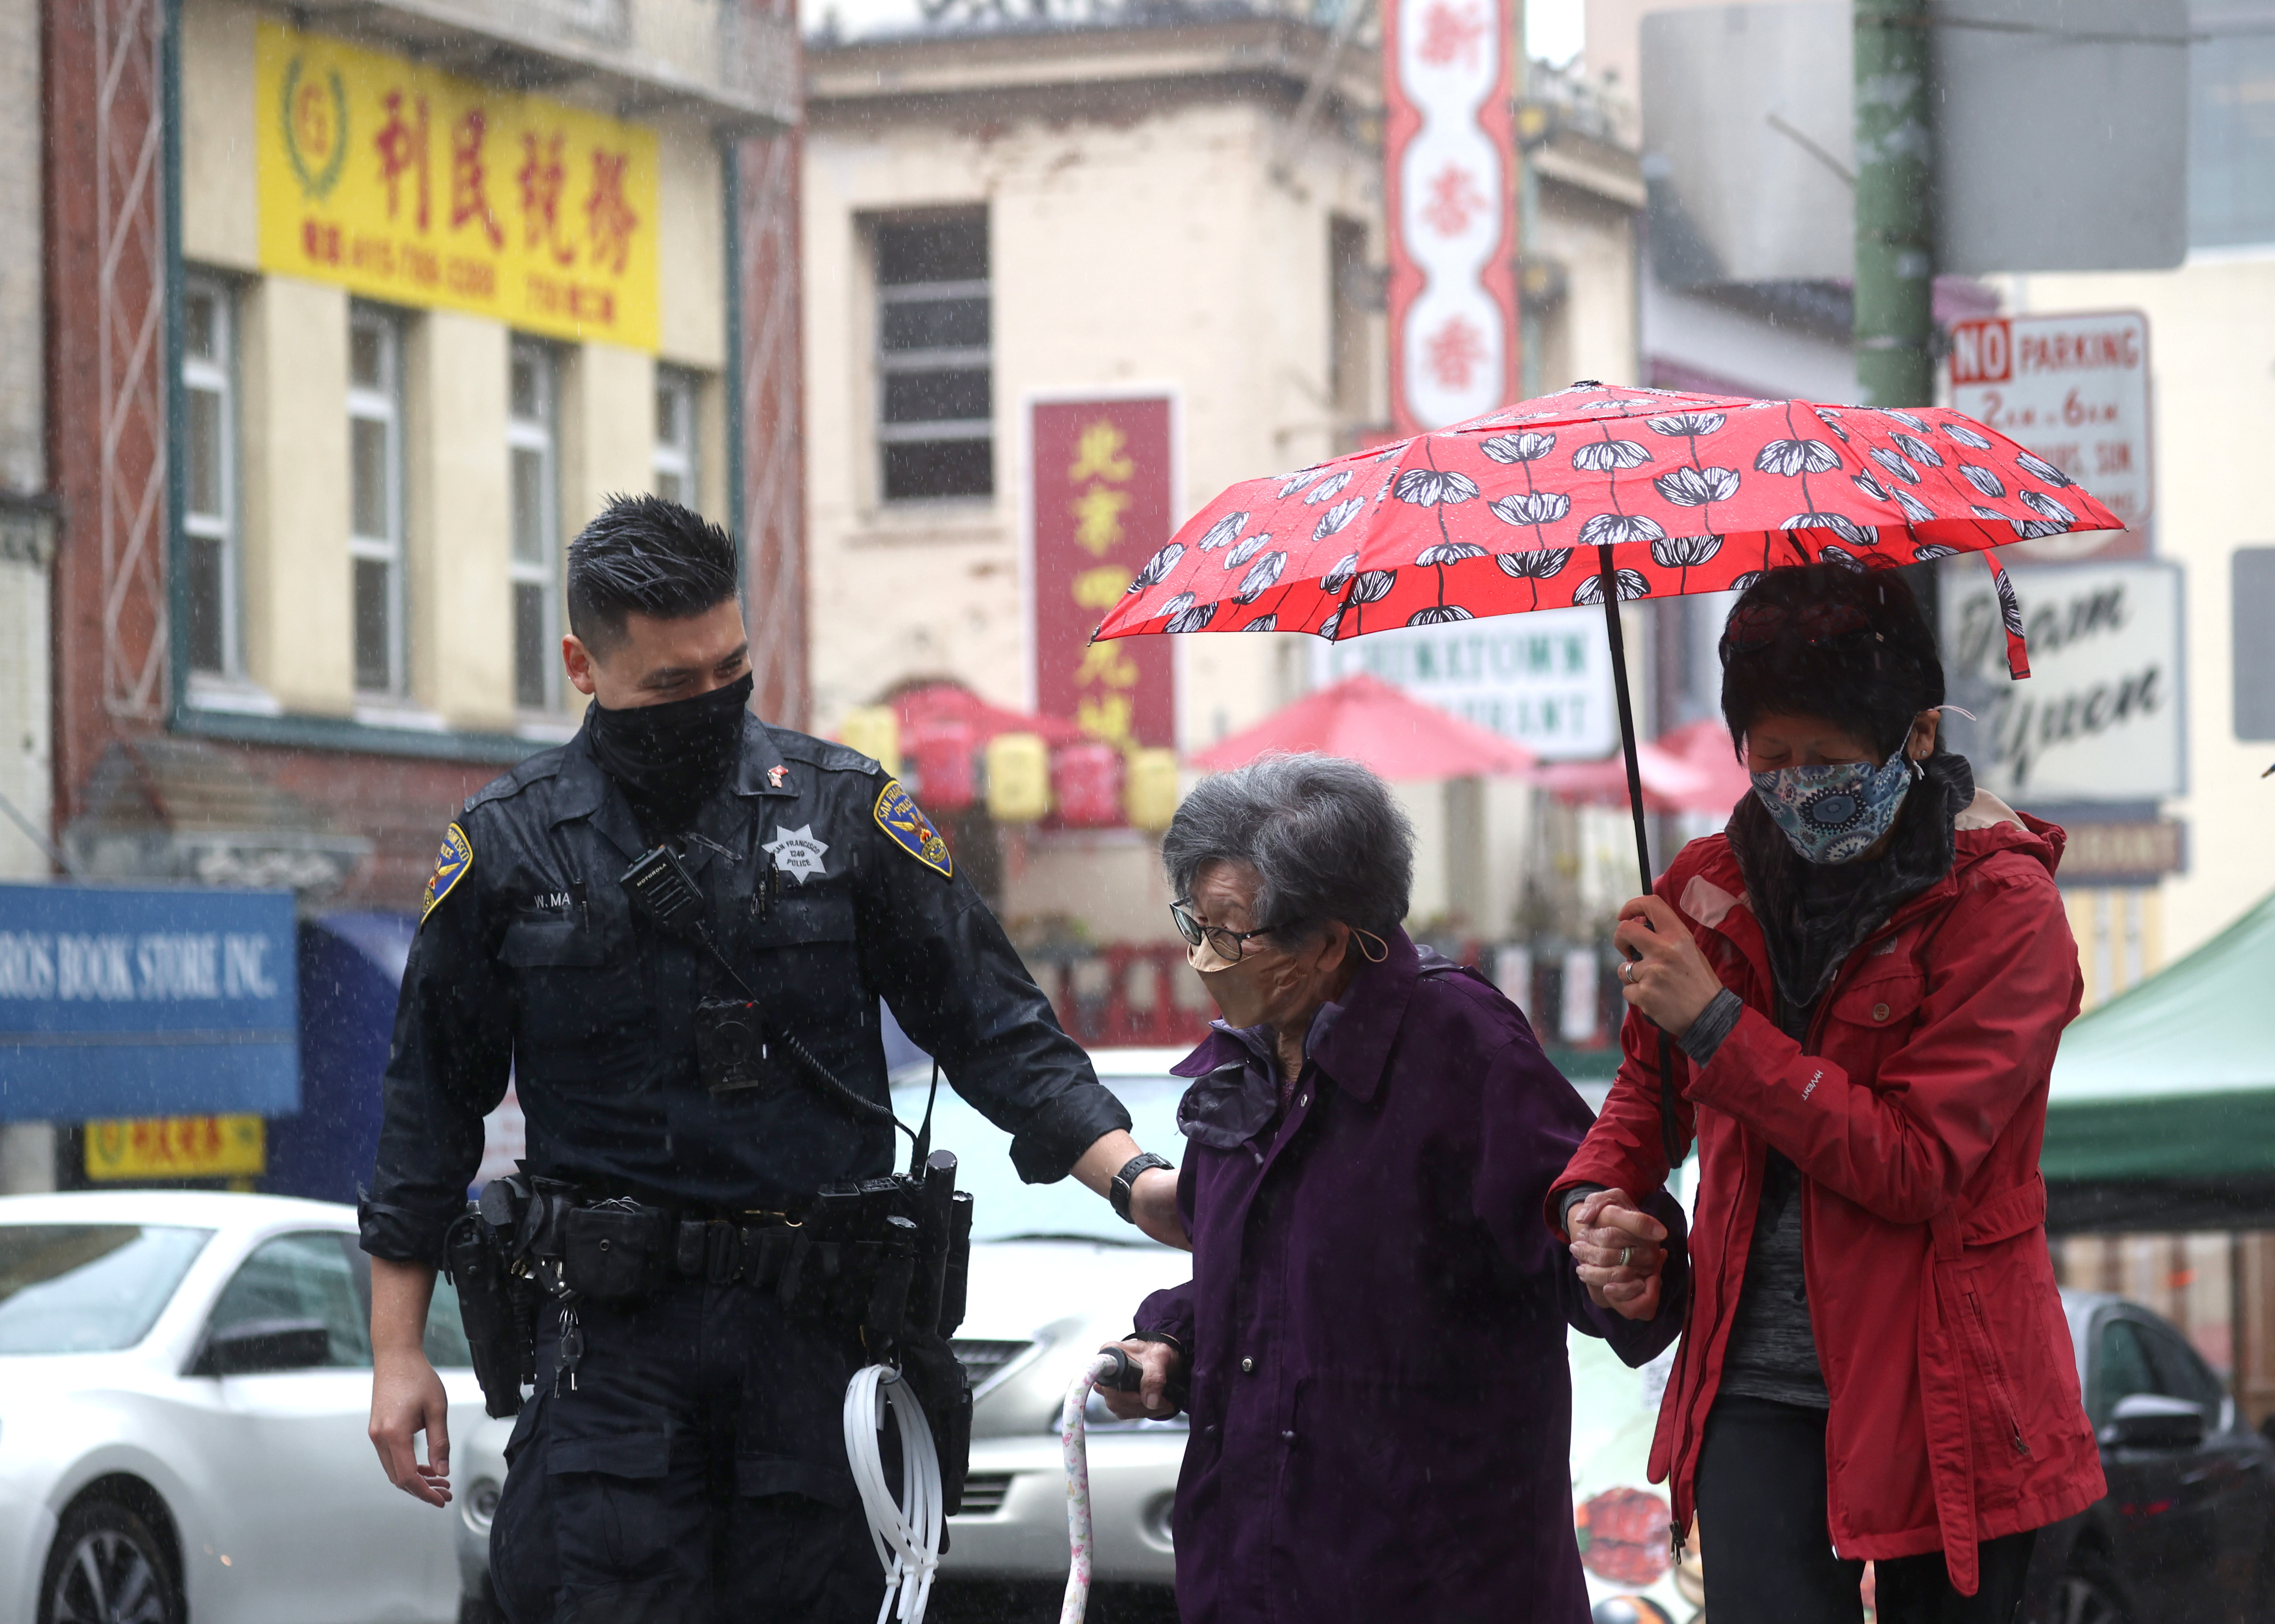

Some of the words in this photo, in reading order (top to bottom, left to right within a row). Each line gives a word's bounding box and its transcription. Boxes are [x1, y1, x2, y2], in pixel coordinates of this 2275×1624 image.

[1955, 325, 2007, 380] NO
[2018, 327, 2139, 373] PARKING
[1989, 666, 2160, 784] Yuen
[878, 799, 892, 820] SAN
[773, 844, 785, 854] SAN
[786, 840, 820, 855] FRANCISCO
[636, 863, 667, 887] MOTOROLA
[57, 932, 135, 1001] BOOK
[138, 933, 216, 1000] STORE
[1801, 1069, 1823, 1101] HYVENT
